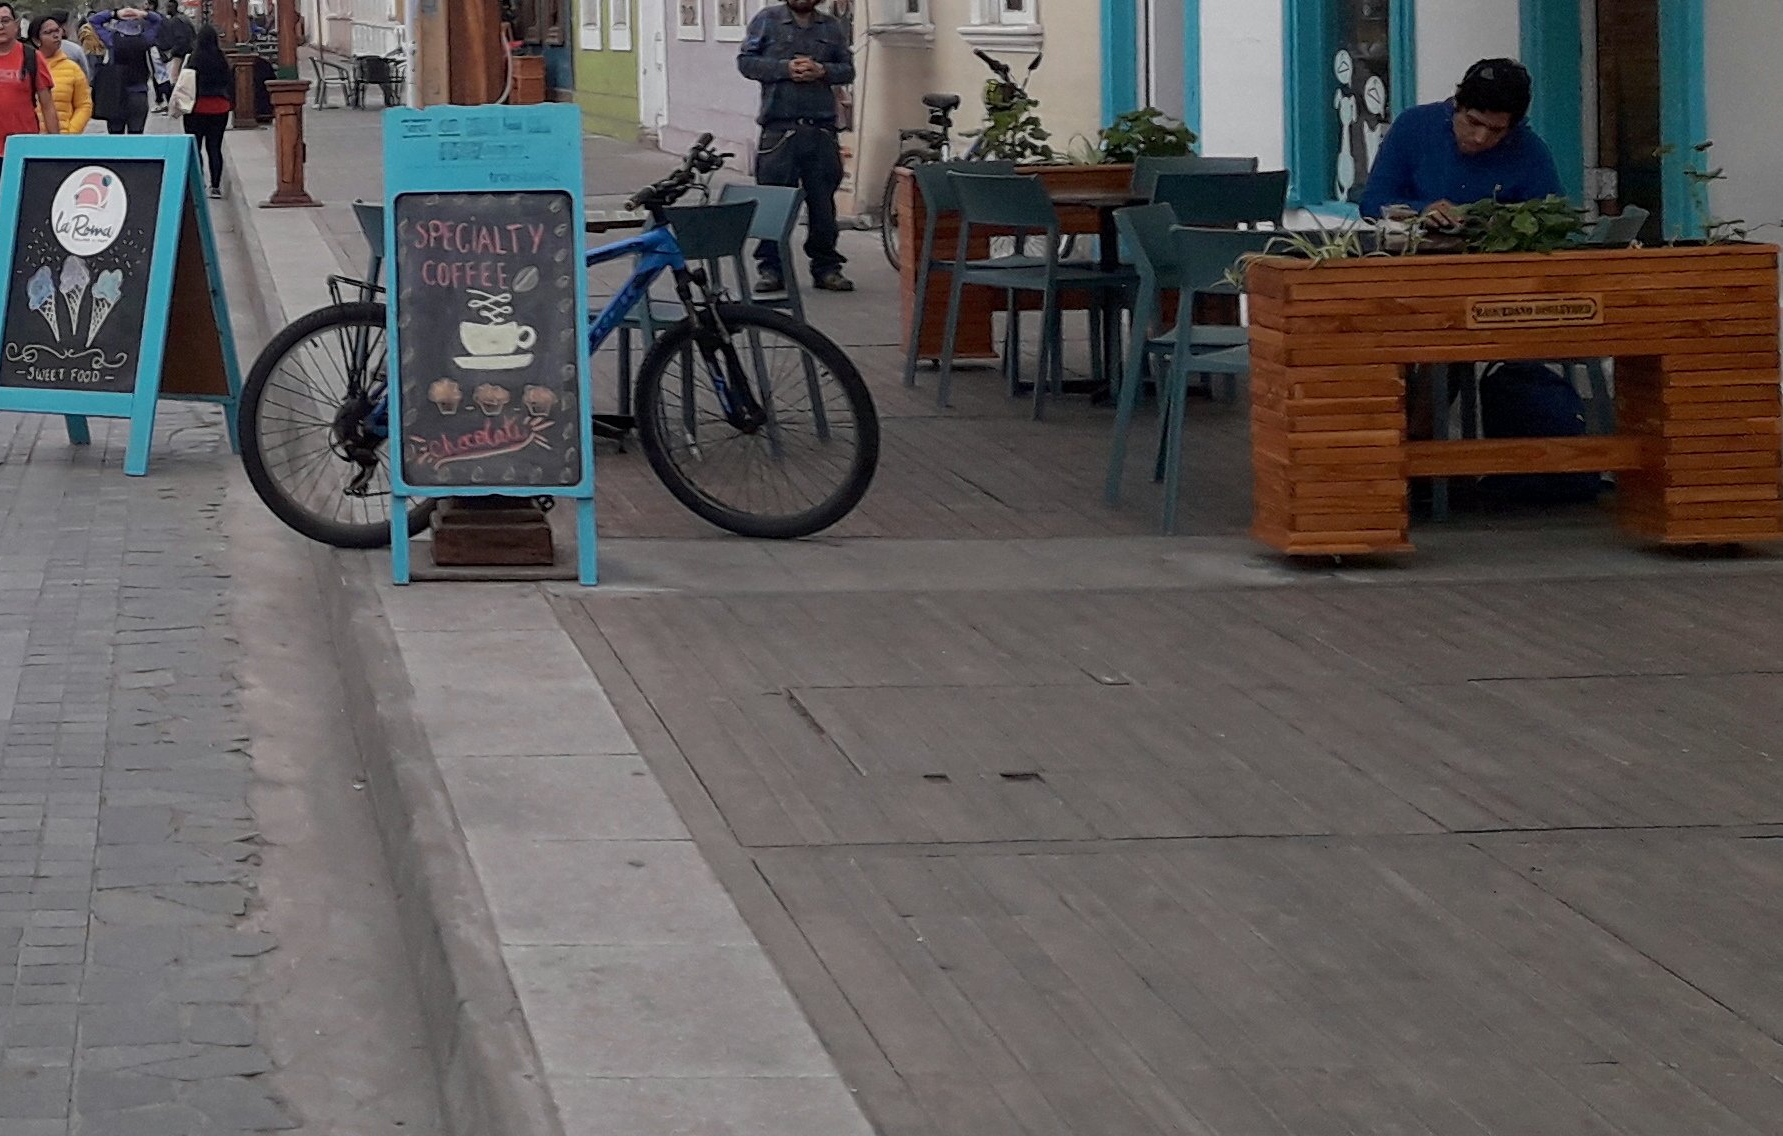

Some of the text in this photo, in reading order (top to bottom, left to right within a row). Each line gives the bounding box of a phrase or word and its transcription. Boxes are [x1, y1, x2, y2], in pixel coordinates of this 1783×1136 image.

[71, 213, 112, 239] Roma
[421, 259, 510, 290] COFFEE
[26, 365, 101, 383] SWEET FOOD
